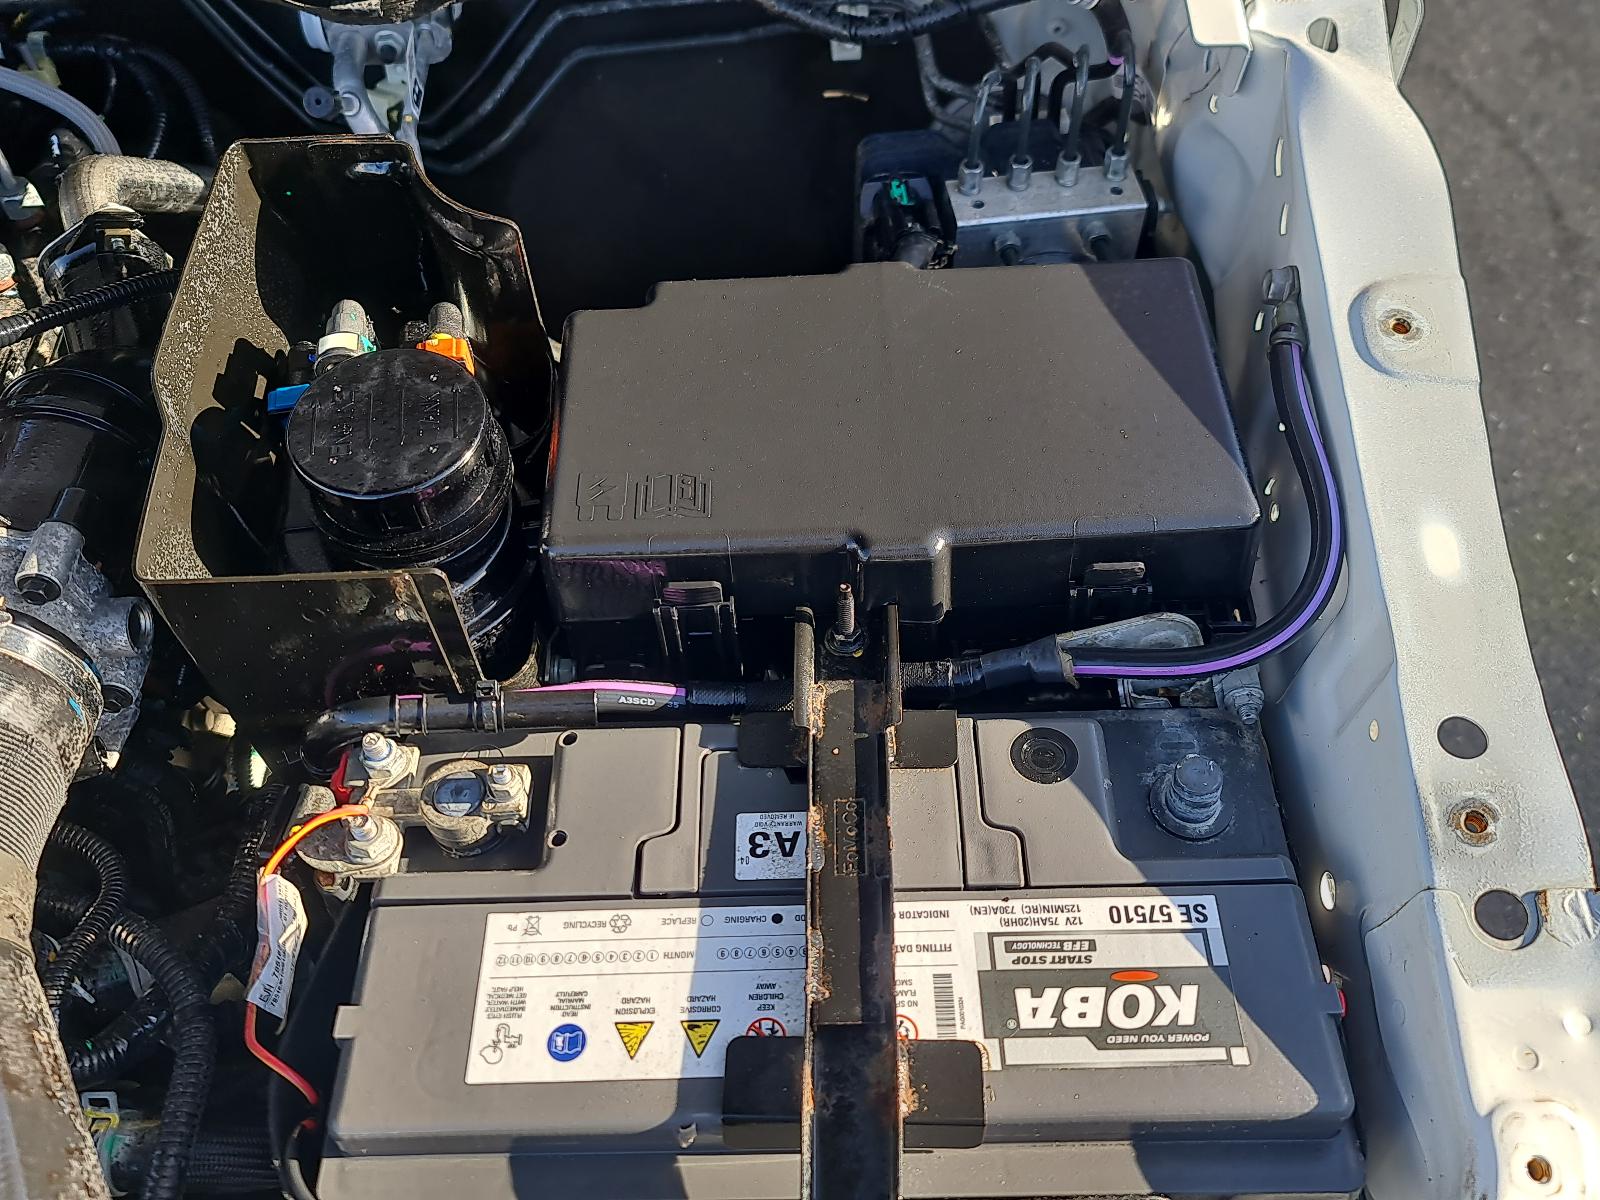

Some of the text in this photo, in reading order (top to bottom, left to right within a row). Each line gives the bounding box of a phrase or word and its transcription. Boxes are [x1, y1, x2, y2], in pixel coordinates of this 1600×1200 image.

[618, 696, 656, 706] A3SCD
[748, 831, 801, 858] A3
[898, 910, 949, 919] INDICATOR
[969, 903, 1081, 916] 125MIN(RC) 730A(EN)
[1108, 903, 1208, 924] SE 57510
[661, 916, 696, 926] REPLACE
[724, 914, 766, 924] CHARGING
[999, 916, 1084, 928] 12V 75AH(20HR)
[508, 924, 517, 932] Pb
[563, 920, 606, 929] RECYCLING
[894, 942, 952, 952] FITTING DAT
[1010, 940, 1090, 952] EFB TECHNOLOGY
[663, 950, 694, 960] MONTH
[1012, 955, 1092, 965] START STOP
[555, 990, 588, 998] CAREFULLY
[686, 995, 716, 1003] HAZARD
[621, 996, 650, 1004] HAZARD
[907, 1000, 918, 1008] NO
[615, 1007, 656, 1015] EXPLOSION
[680, 1005, 722, 1014] CORROSIVE
[756, 1004, 775, 1012] KEEP
[1014, 983, 1199, 1030] KOBA
[1106, 1032, 1210, 1044] POWER YOU NEED
